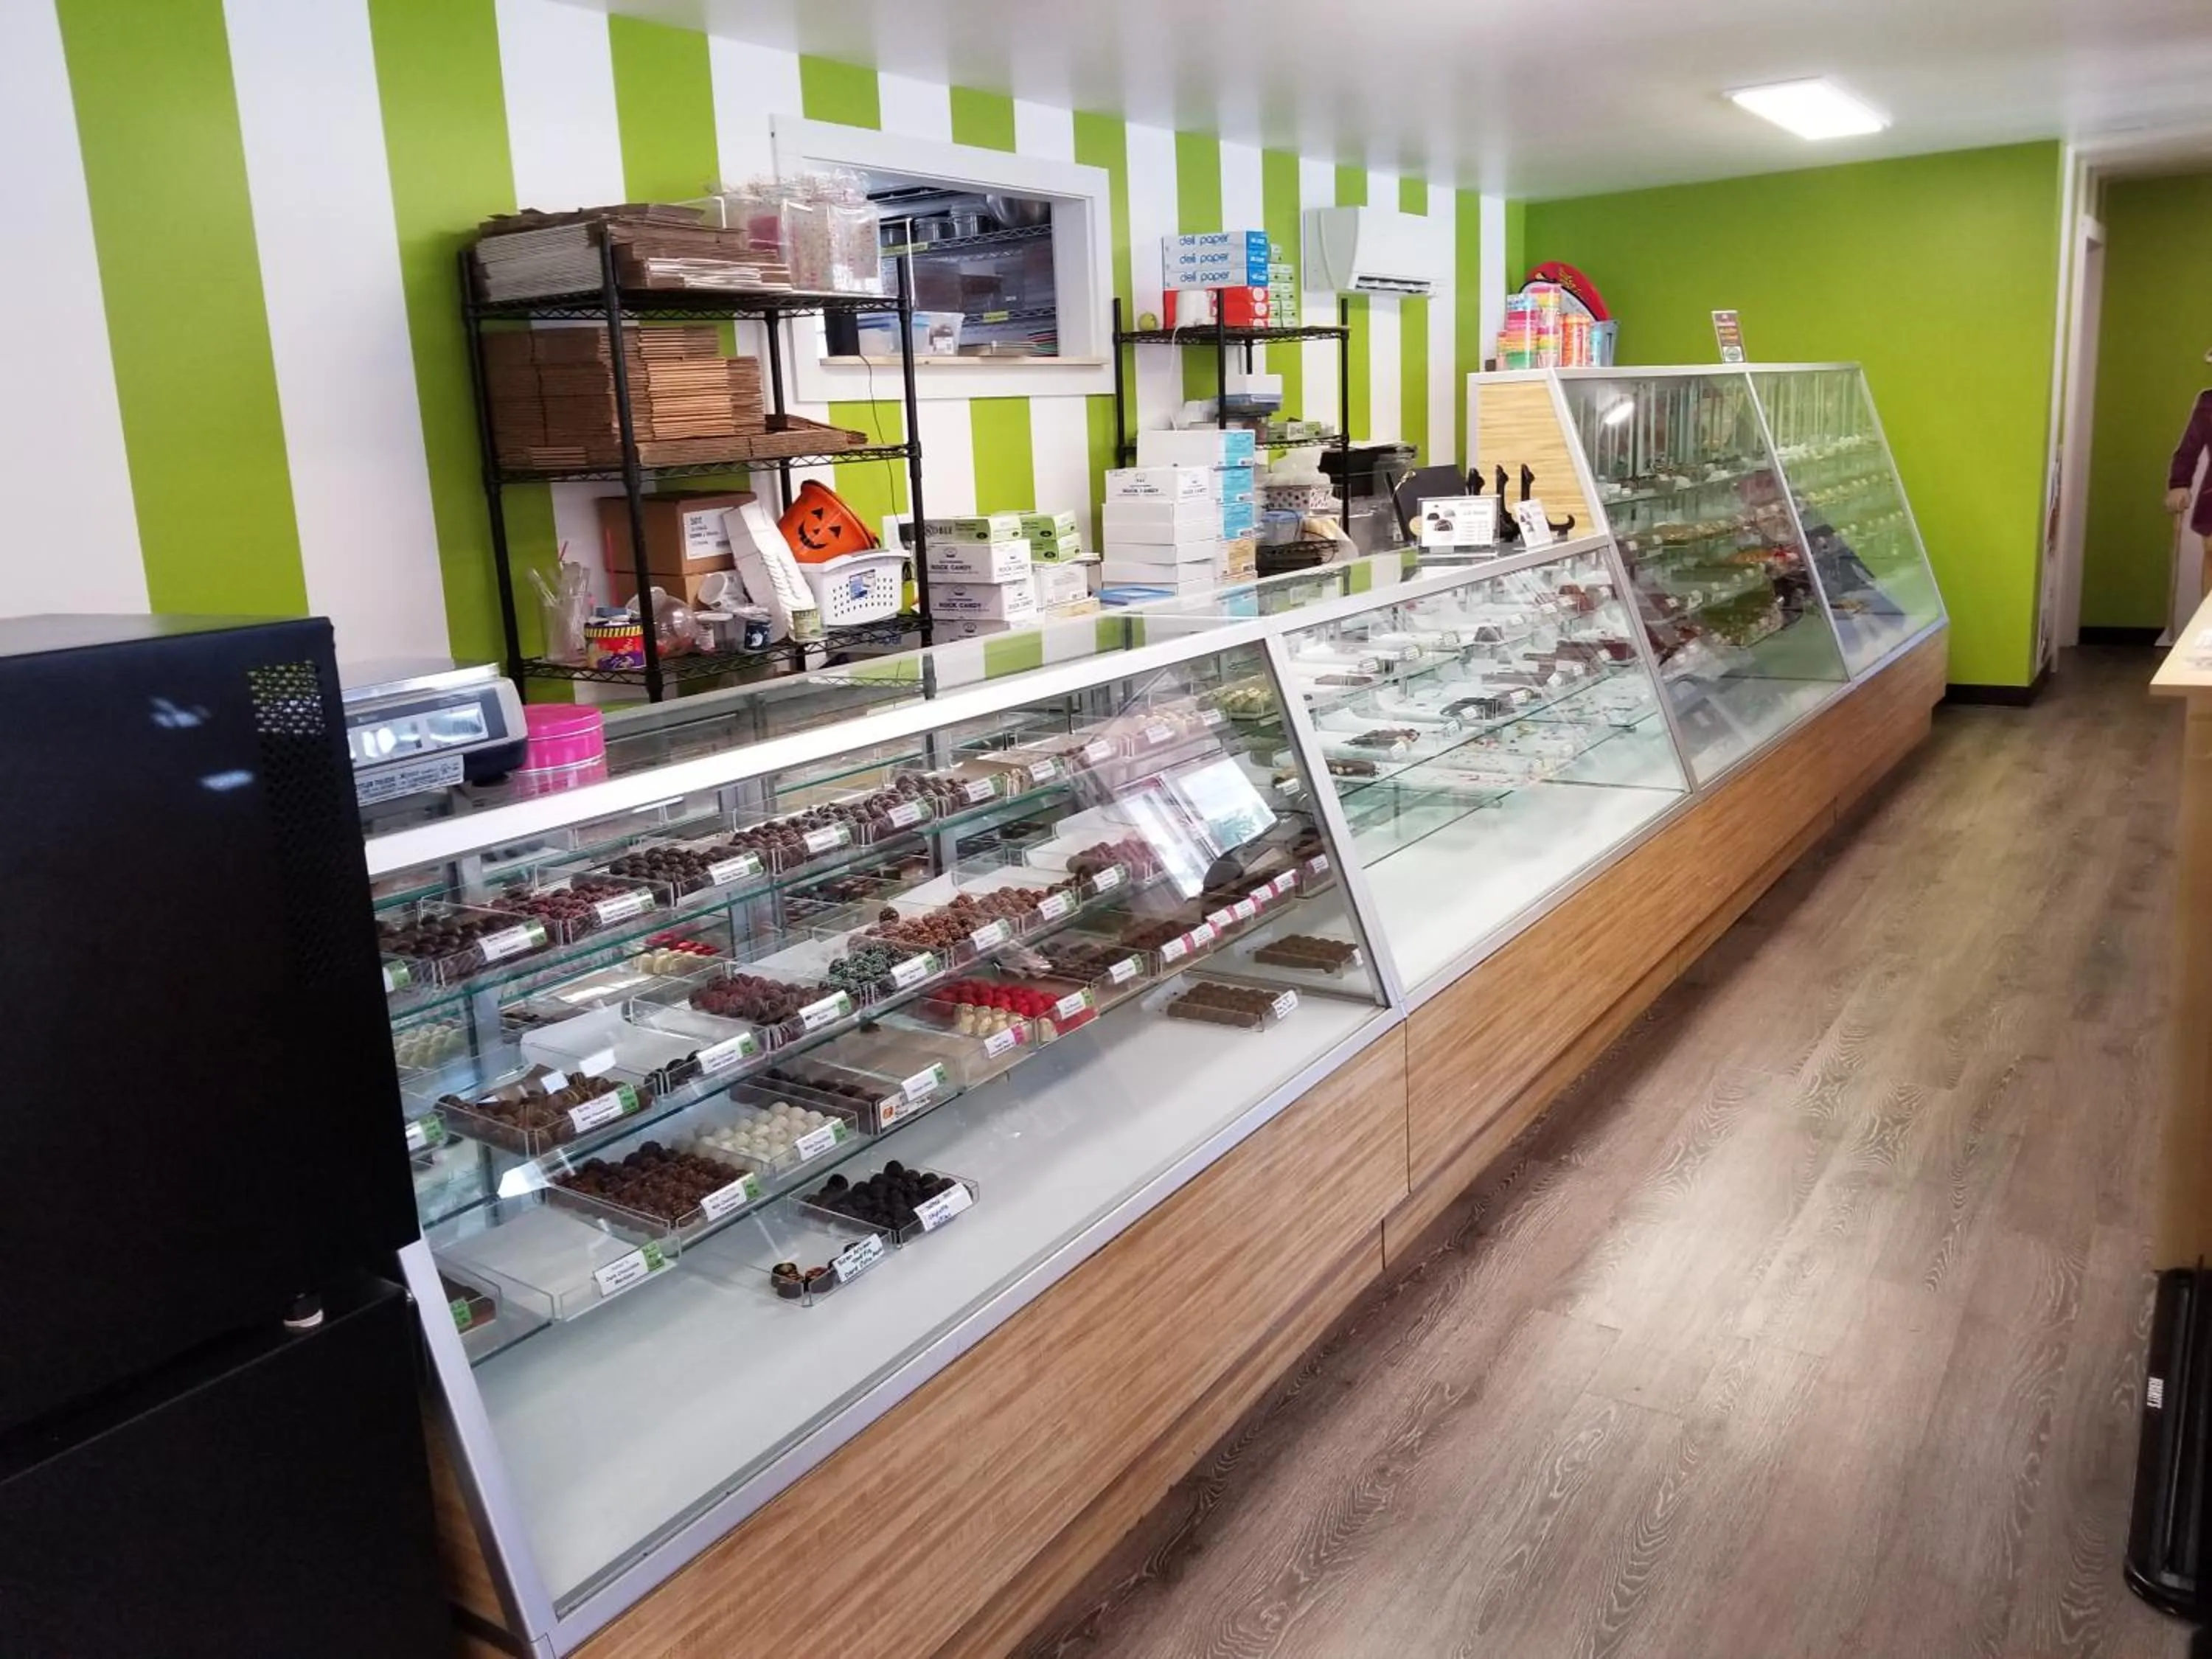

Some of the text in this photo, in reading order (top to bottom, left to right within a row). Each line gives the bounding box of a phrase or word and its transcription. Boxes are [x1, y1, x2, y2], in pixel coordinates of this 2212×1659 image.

[1180, 234, 1229, 246] deli paper
[1180, 252, 1228, 264] deli paper
[1180, 271, 1230, 282] deli paper
